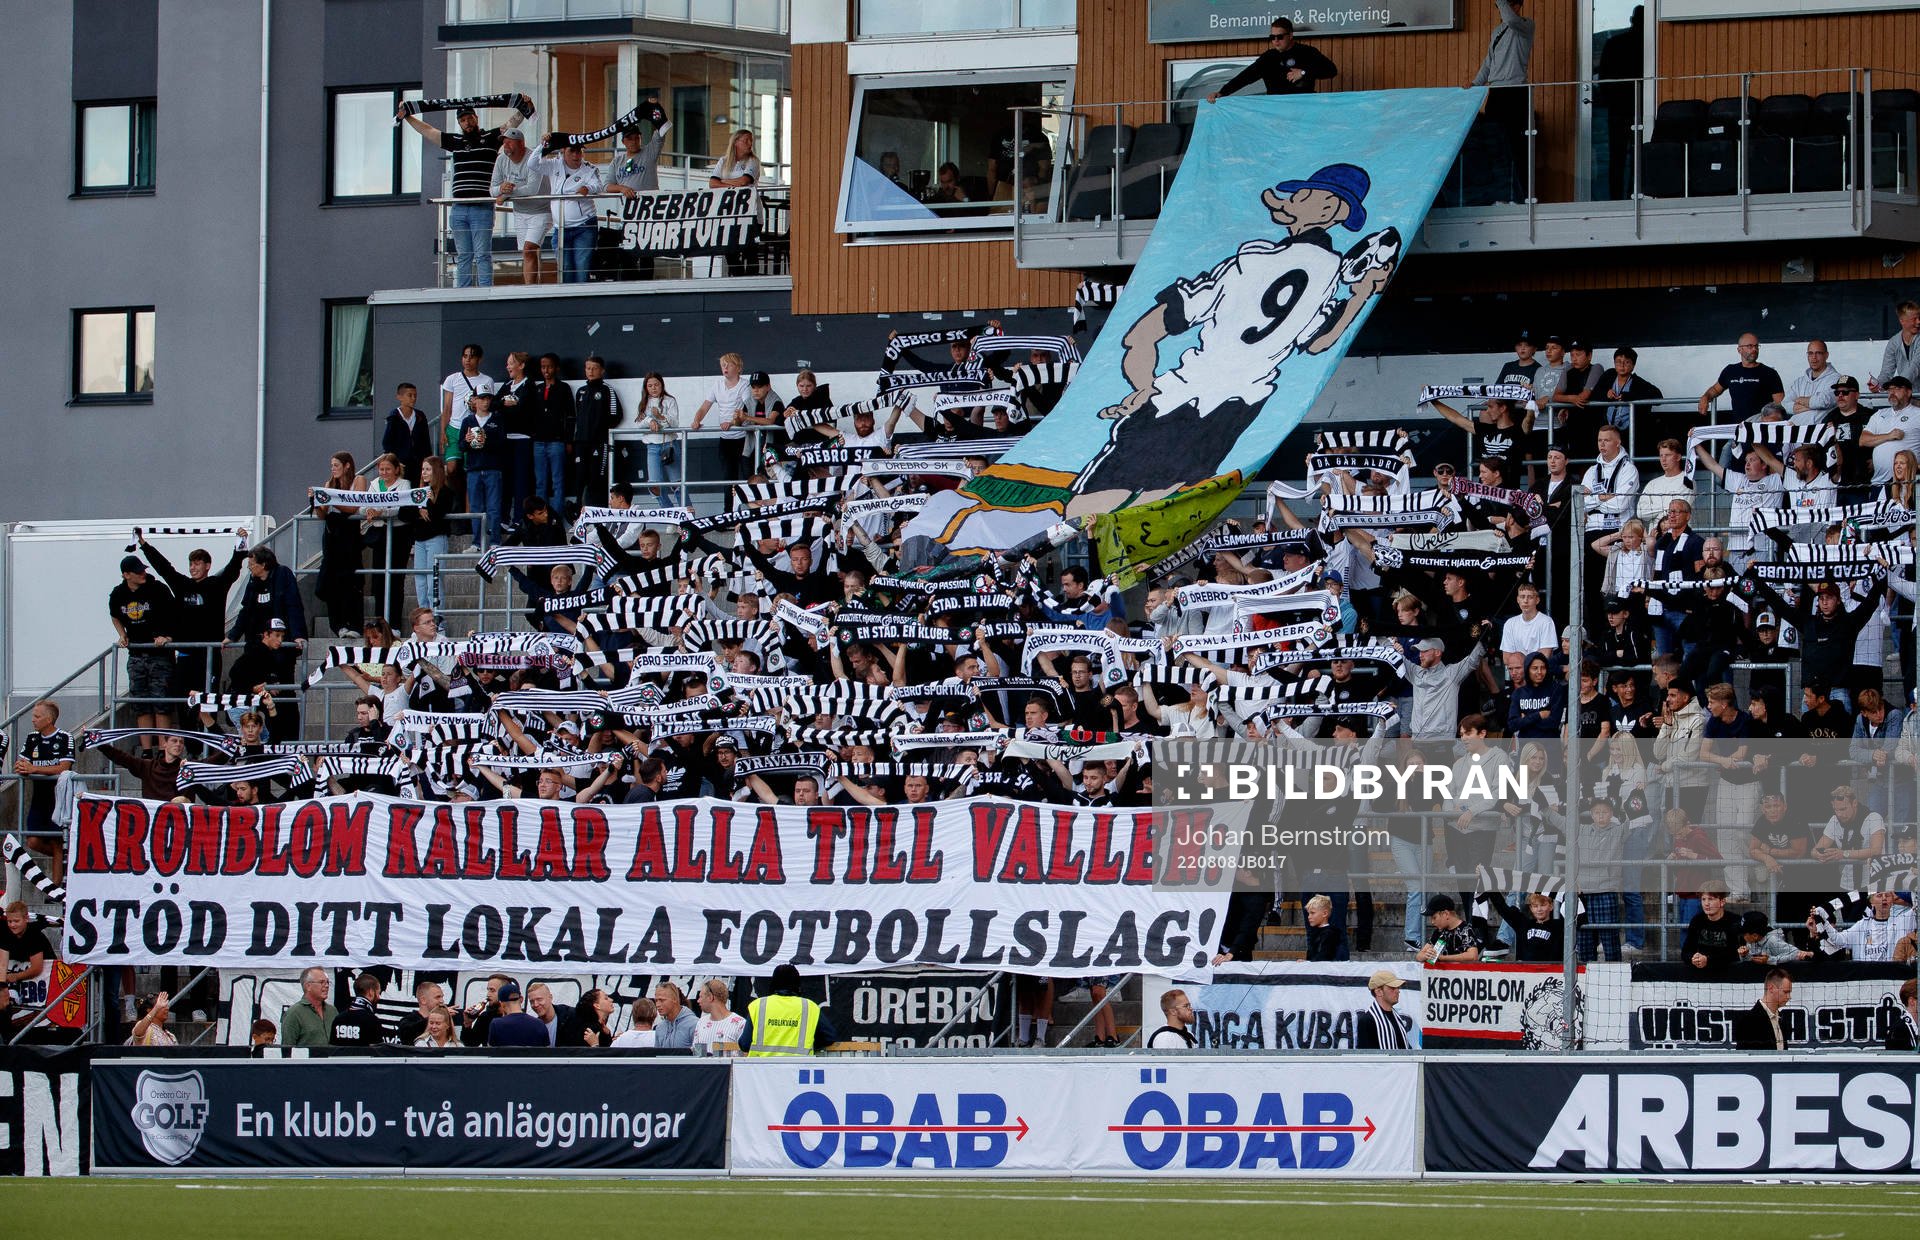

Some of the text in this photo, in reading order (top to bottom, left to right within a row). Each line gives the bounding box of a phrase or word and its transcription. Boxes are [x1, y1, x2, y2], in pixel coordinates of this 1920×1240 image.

[1293, 9, 1304, 24] &
[1308, 6, 1391, 25] Rekrytering
[621, 110, 638, 127] SK
[717, 186, 752, 216] ÄR
[623, 217, 754, 251] SVARTVITT
[1240, 268, 1310, 345] 9
[946, 328, 968, 341] SK
[888, 368, 988, 388] EYRAVALLEN
[935, 396, 960, 409] AMLA
[962, 393, 983, 404] FINA
[854, 449, 872, 460] SK
[1363, 456, 1397, 471] ALDRI
[934, 461, 949, 470] SK
[338, 491, 400, 503] MALMBERGS
[583, 509, 615, 520] AMLA
[618, 509, 645, 519] FINA
[692, 518, 711, 530] EN
[759, 504, 780, 516] EN
[1271, 527, 1313, 542] TILLBAK
[1496, 555, 1531, 566] PASSION
[938, 579, 970, 590] PASSION
[591, 588, 605, 604] SK
[963, 595, 978, 609] EN
[857, 625, 953, 641] EN STAD. EN KLUBB.
[995, 622, 1025, 635] STAD.
[1027, 633, 1057, 651] REBRO
[1185, 635, 1229, 648] GAMLA
[1232, 631, 1260, 643] FINA
[734, 752, 829, 775] EYRAVALLEN
[73, 799, 374, 877] KRONBLOM
[382, 804, 612, 882] KALLAR
[626, 804, 786, 884] ALLA
[806, 803, 945, 885] TILL
[68, 882, 1216, 970] STÖD DITT LOKALA FOTBOLLSLAG!
[1427, 976, 1525, 1002] KRONBLOM
[1426, 1003, 1503, 1025] SUPPORT
[1638, 999, 1809, 1045] VÄSTA
[335, 1024, 360, 1039] 1908
[1192, 1009, 1265, 1050] NGA
[175, 1090, 192, 1100] City
[134, 1102, 207, 1130] GOLF
[237, 1103, 274, 1137] En
[283, 1101, 377, 1138] klubb
[404, 1101, 456, 1138] två
[464, 1101, 687, 1149] anläggningar
[780, 1069, 1010, 1170] ÖBAB
[1122, 1068, 1356, 1170] ÖBAB
[1527, 1072, 1920, 1171] ARBES
